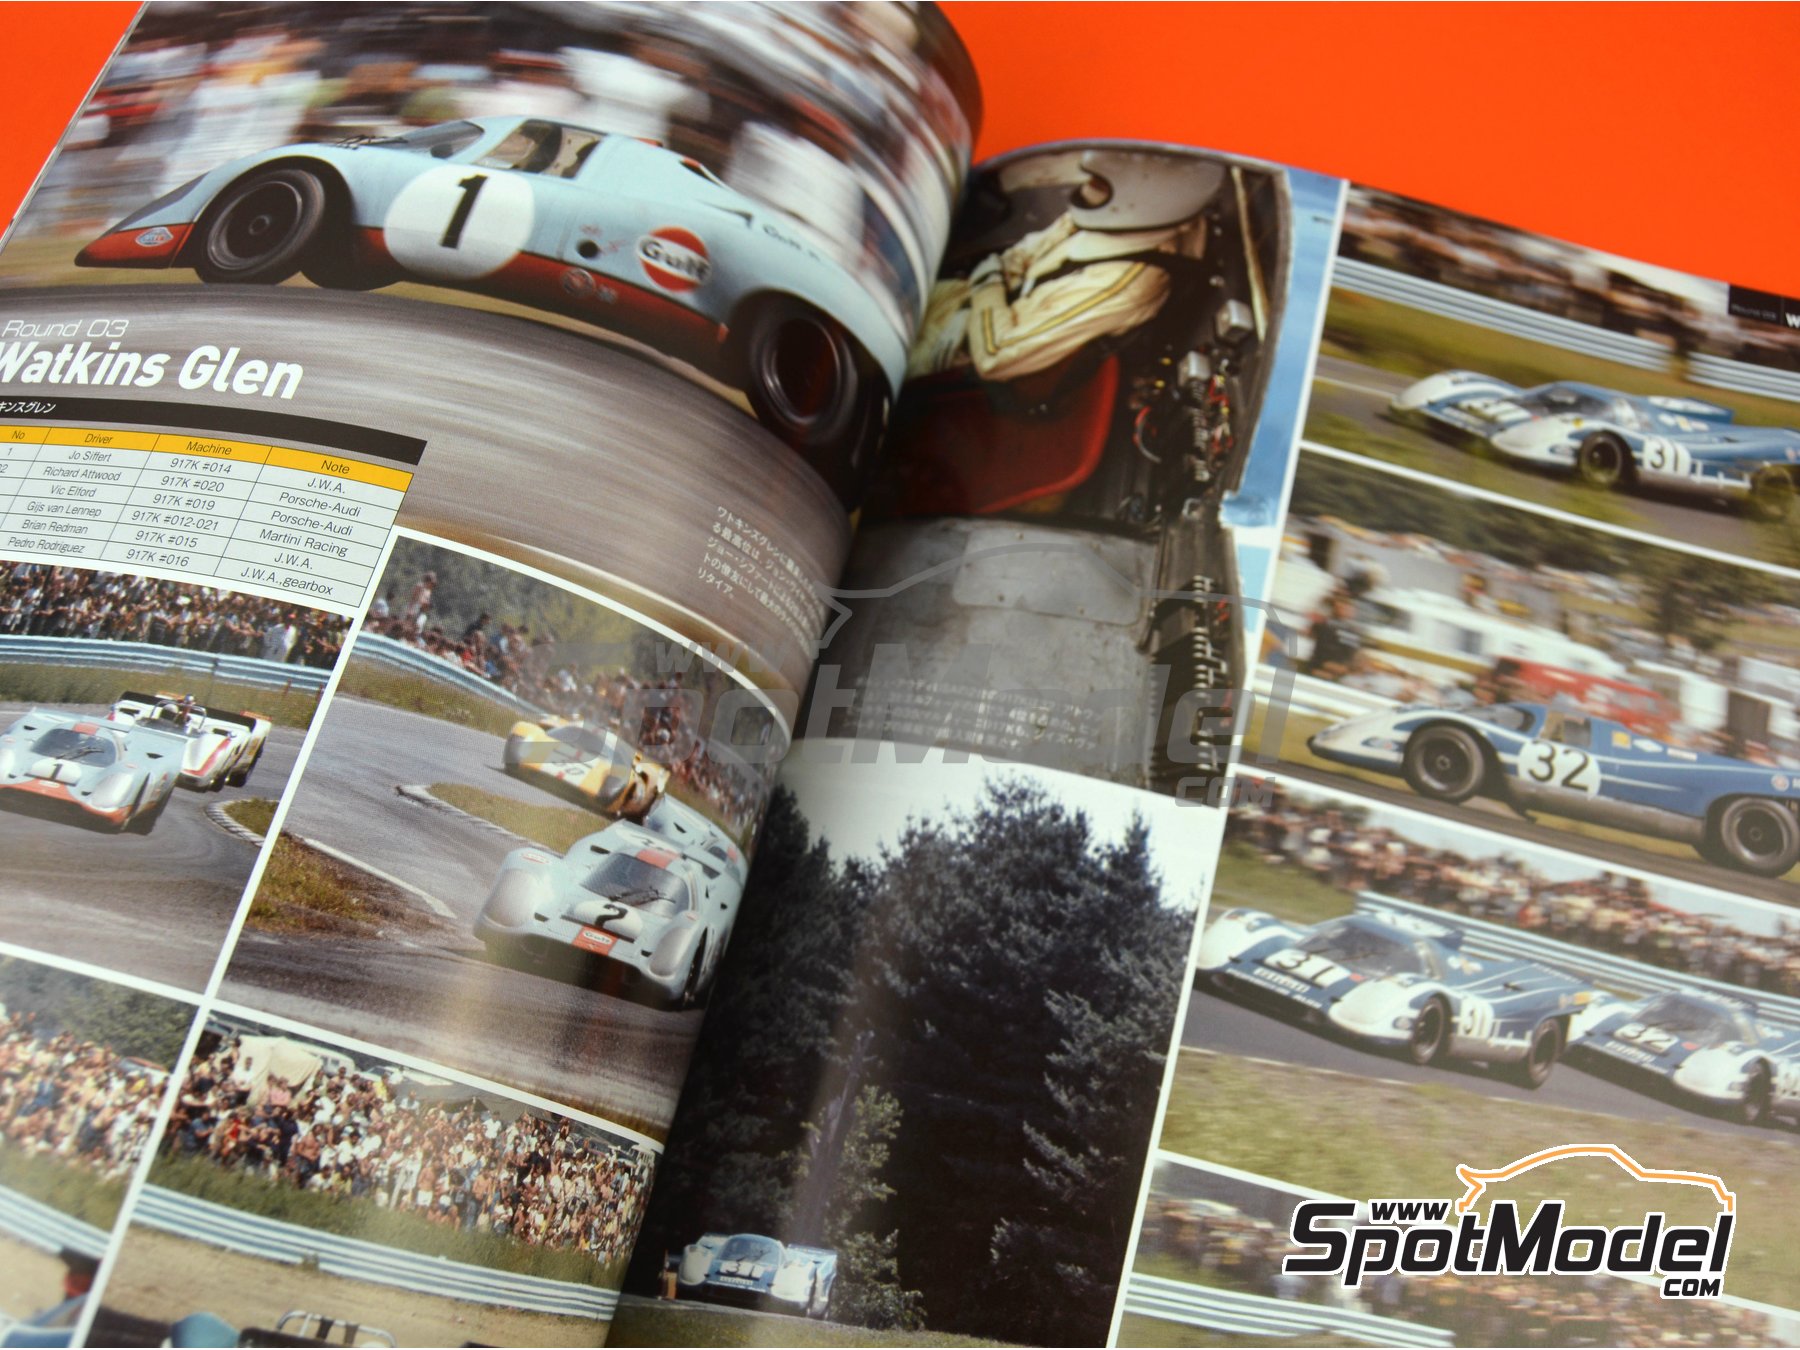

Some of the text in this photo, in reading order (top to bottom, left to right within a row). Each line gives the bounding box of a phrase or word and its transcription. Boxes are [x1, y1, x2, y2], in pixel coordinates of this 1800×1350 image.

[439, 174, 489, 250] 1
[2, 318, 129, 337] Round 03
[0, 341, 303, 400] Watkins Glen
[11, 430, 25, 440] No
[84, 433, 113, 444] Driver
[8, 447, 13, 456] 1
[68, 450, 111, 462] Jo Siffert
[186, 441, 232, 455] Machine
[1650, 438, 1680, 472] 31
[43, 466, 121, 481] Richard Attwood
[170, 457, 232, 474] 917K #014
[320, 459, 350, 474] Note
[50, 485, 97, 498] Vic Elford
[161, 475, 224, 493] 917K #020
[307, 477, 346, 493] J.W.A.
[27, 501, 102, 518] Gijs van Lennep
[152, 493, 216, 511] 917K #019
[278, 491, 361, 518] Porsche-Audi
[21, 519, 88, 534] Brian Redman
[131, 510, 219, 531] 917K #012-021
[270, 510, 353, 537] Porsche-Audi
[7, 537, 86, 554] Pedro Rodriguez
[135, 530, 198, 548] 917K #015
[259, 528, 349, 557] Martini Racing
[126, 548, 190, 567] 917K #016
[274, 552, 313, 569] J.W.A.
[1527, 739, 1590, 792] 32
[594, 903, 628, 928] 2
